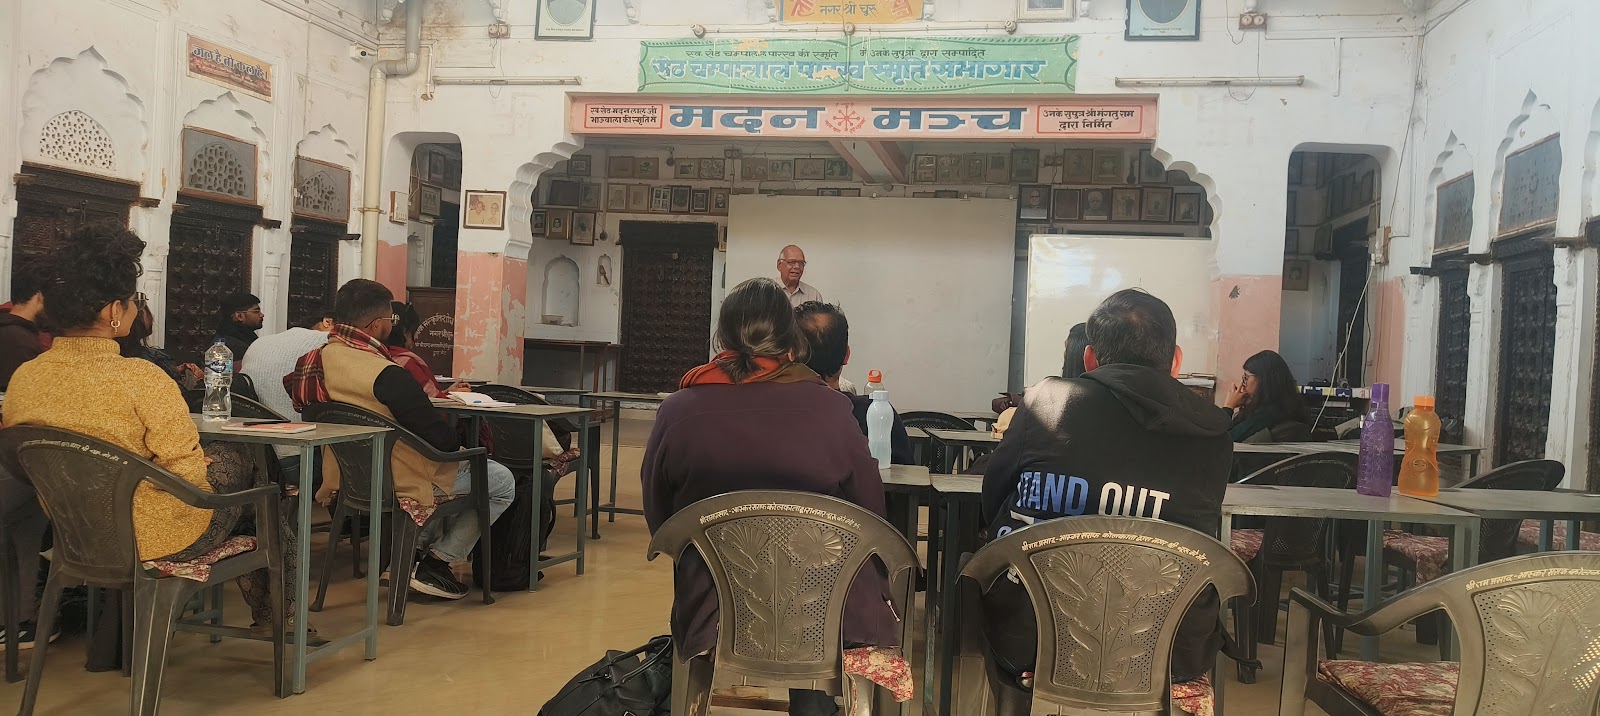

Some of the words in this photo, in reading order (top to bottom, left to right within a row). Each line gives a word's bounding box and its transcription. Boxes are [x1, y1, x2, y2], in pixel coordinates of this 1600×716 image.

[820, 5, 842, 17] नगर
[843, 1, 857, 14] श्री
[797, 48, 811, 57] की
[812, 48, 839, 60] स्मृति
[612, 107, 630, 115] मदन
[647, 105, 657, 116] जी
[1043, 108, 1063, 118] उनके
[1064, 110, 1085, 119] सुपुत्र
[1086, 108, 1096, 117] श्री
[622, 115, 631, 124] की
[632, 115, 649, 126] स्मृति
[669, 105, 826, 134] मदन
[1058, 120, 1079, 131] द्वारा
[1082, 119, 1113, 130] निर्मित
[1098, 481, 1171, 522] OUT
